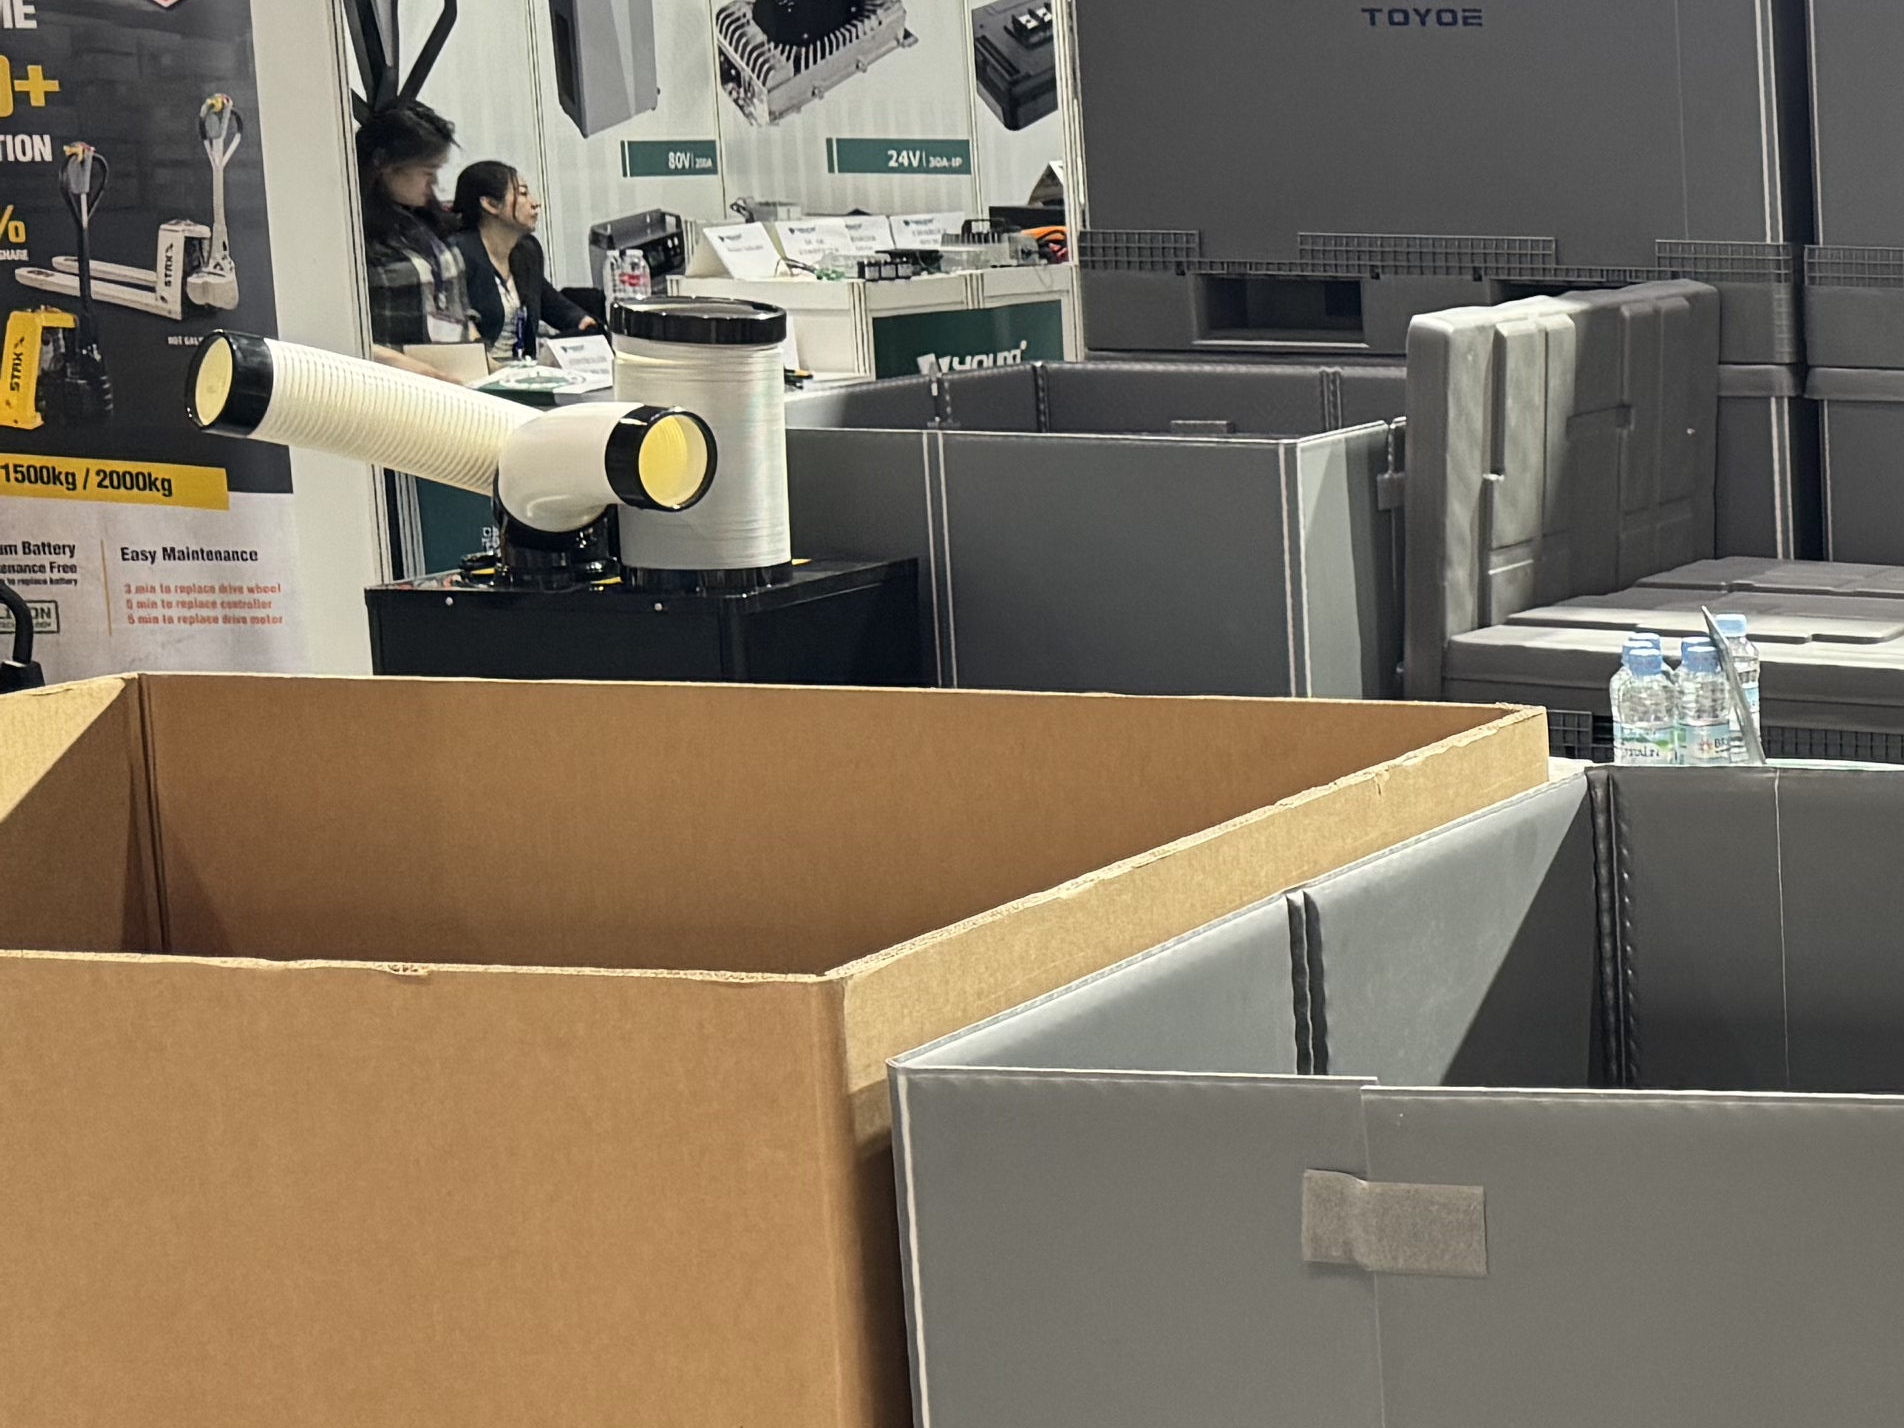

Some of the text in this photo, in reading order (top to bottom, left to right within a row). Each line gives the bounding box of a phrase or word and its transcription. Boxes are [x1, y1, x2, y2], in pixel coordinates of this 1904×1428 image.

[1361, 6, 1484, 29] TOYOE
[668, 151, 691, 169] 80V
[887, 150, 921, 168] 24V
[0, 463, 78, 491] 1500kg
[96, 469, 174, 498] 2000kg
[22, 540, 76, 559] Battery
[121, 546, 259, 565] Easy Maintenance
[49, 560, 78, 574] Free
